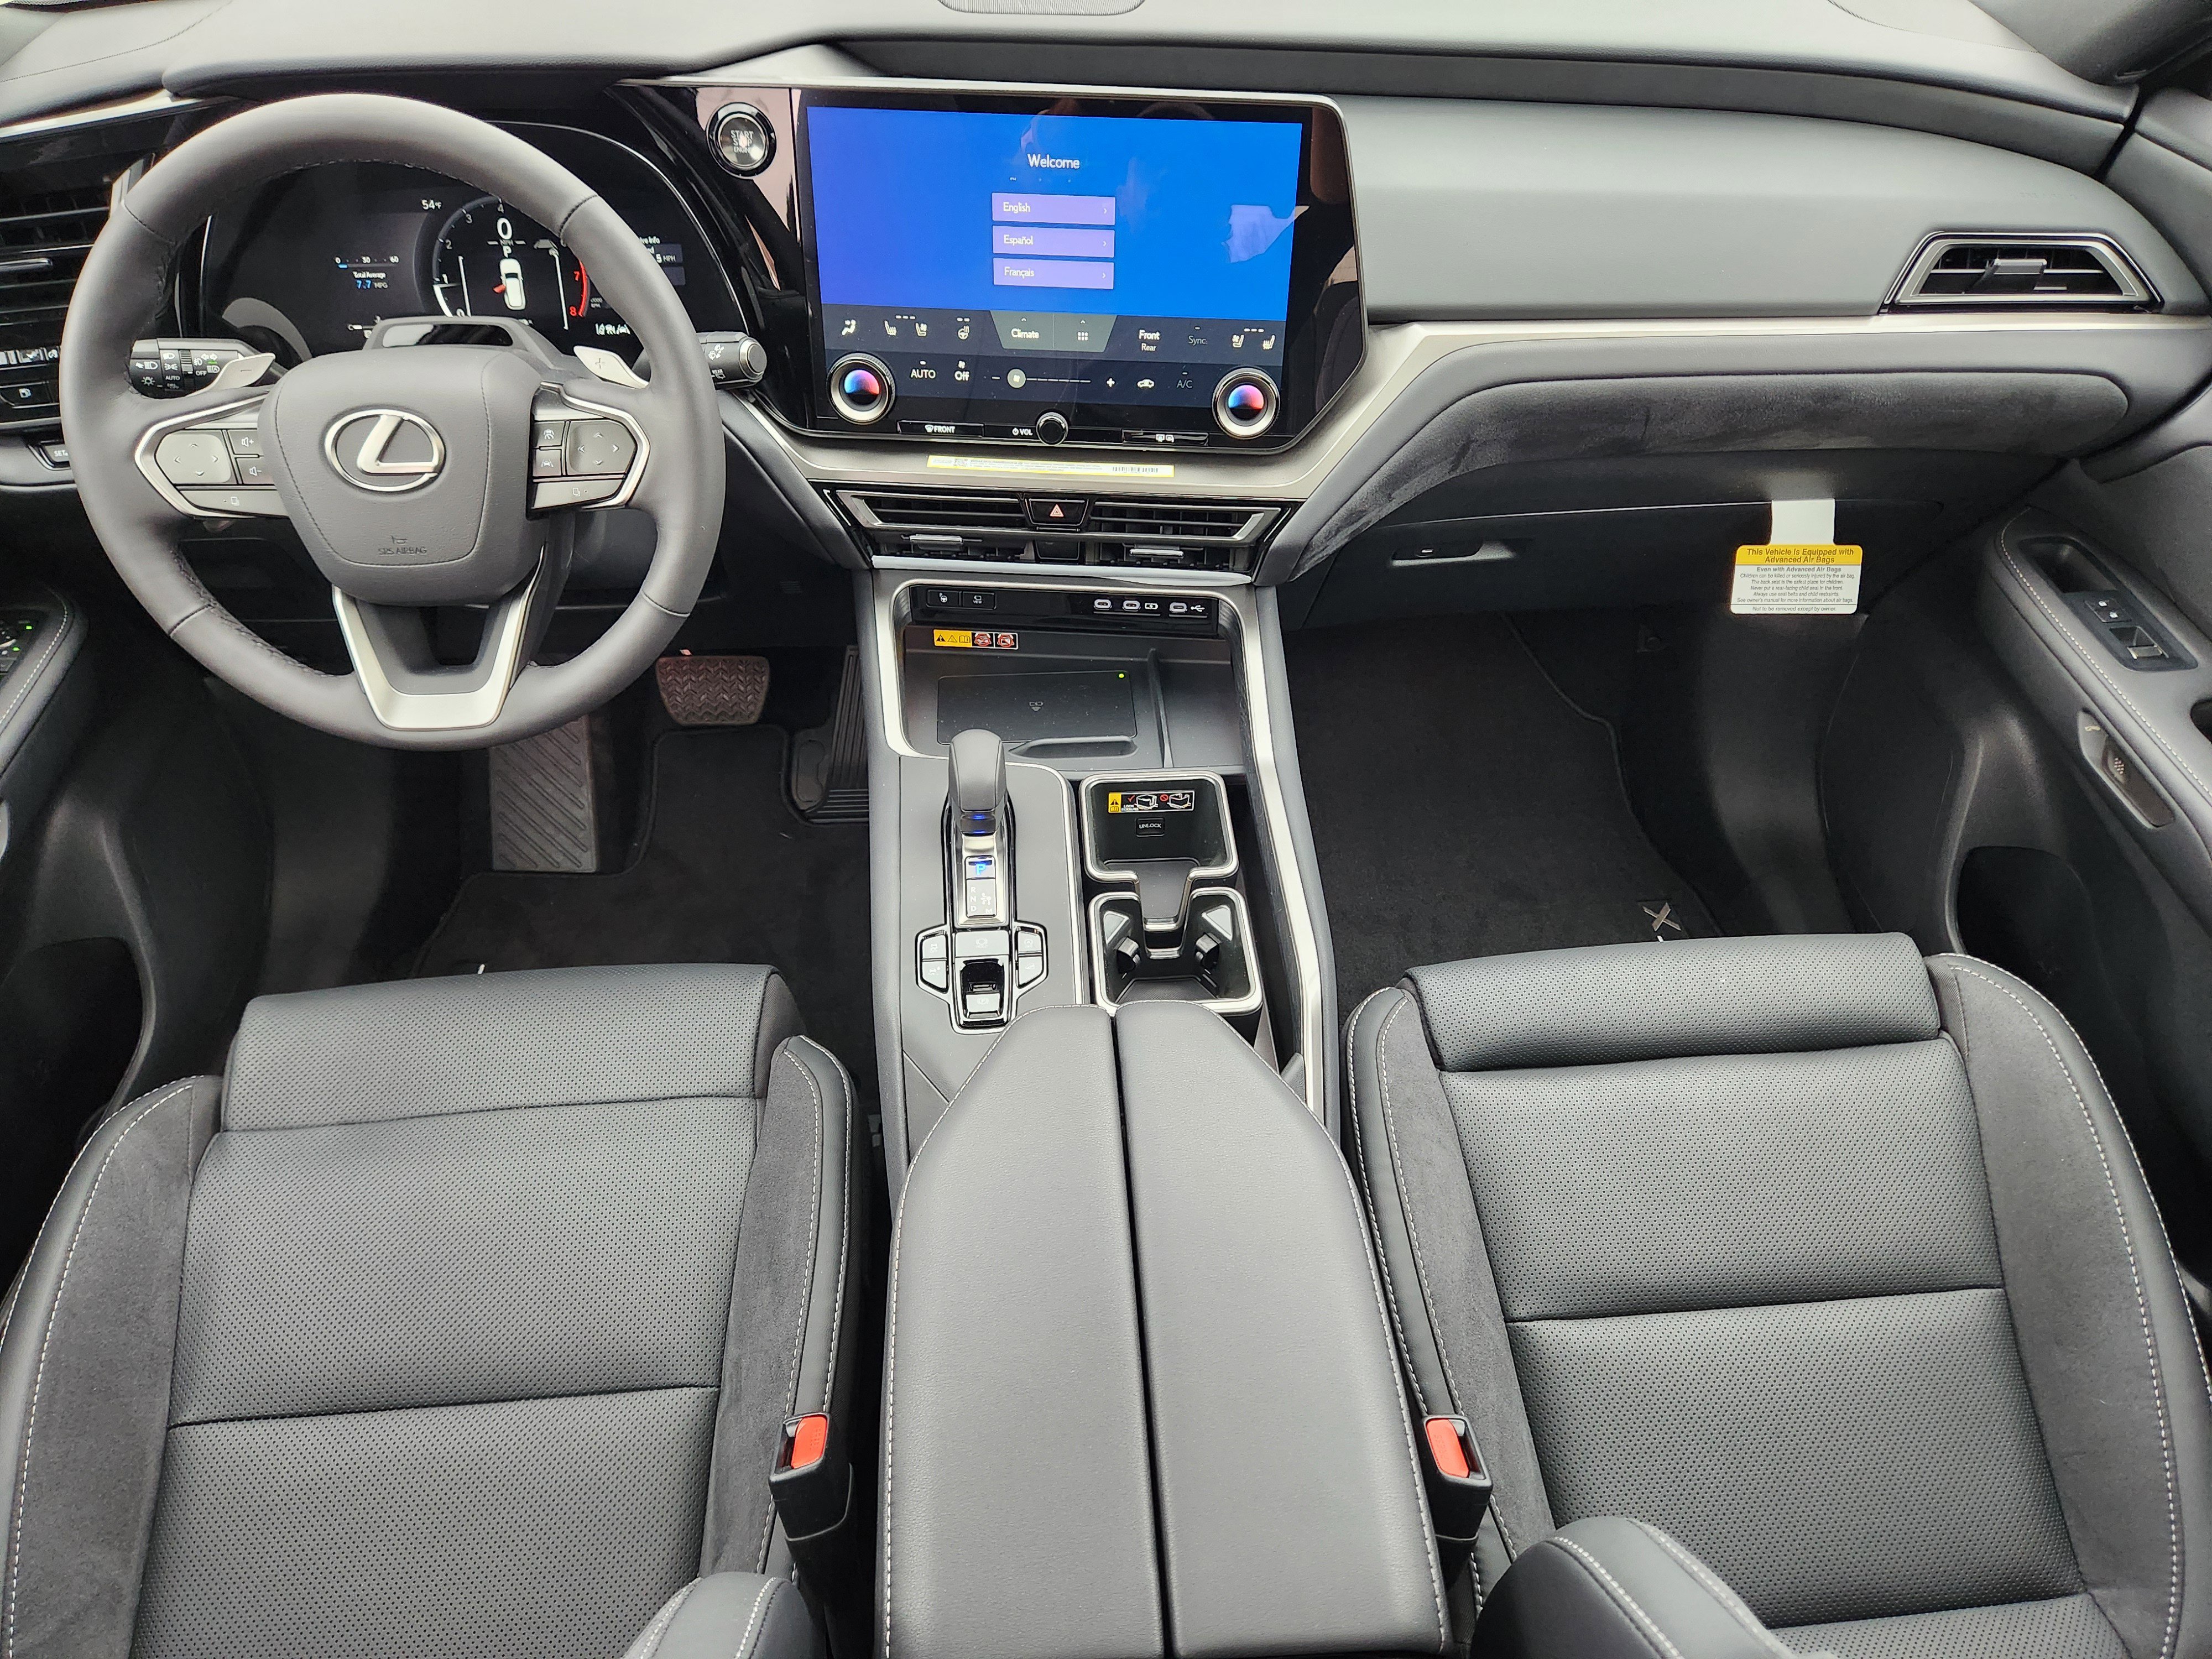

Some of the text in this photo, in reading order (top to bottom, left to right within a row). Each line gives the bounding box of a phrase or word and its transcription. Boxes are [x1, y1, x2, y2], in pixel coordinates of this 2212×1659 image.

[731, 130, 754, 139] START
[733, 138, 752, 147] STP
[1027, 154, 1080, 169] Welcome
[1003, 202, 1031, 213] English
[466, 213, 472, 224] 3
[497, 217, 513, 240] 0
[445, 240, 452, 249] 2
[1004, 234, 1034, 246] Español
[503, 246, 512, 258] P
[573, 270, 580, 281] 7
[1004, 267, 1035, 279] Français
[356, 280, 372, 289] 7.7
[442, 274, 448, 284] 1
[570, 306, 577, 316] 8
[1011, 328, 1040, 339] Climate
[1139, 329, 1160, 341] Front
[1141, 343, 1157, 352] Rear
[911, 369, 936, 379] AUTO
[954, 371, 969, 382] Off
[1177, 379, 1193, 389] A/C
[1802, 549, 1837, 557] Equipped
[976, 864, 986, 875] P
